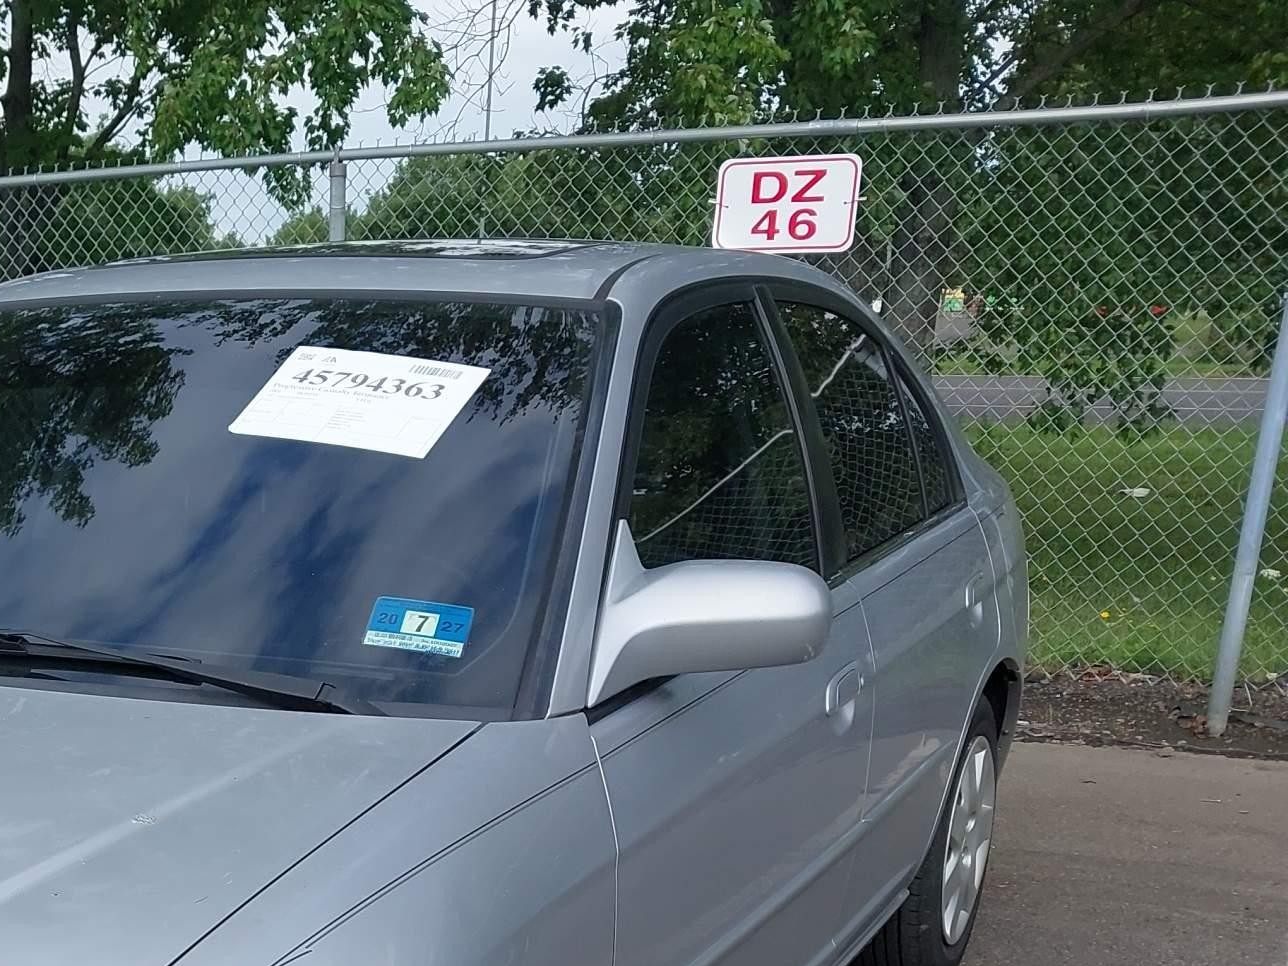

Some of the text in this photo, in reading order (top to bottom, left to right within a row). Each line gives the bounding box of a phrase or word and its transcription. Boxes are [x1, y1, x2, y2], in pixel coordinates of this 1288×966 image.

[751, 169, 828, 204] DZ
[750, 208, 818, 241] 46
[292, 368, 446, 400] 45794363
[377, 612, 465, 634] 20 7 27
